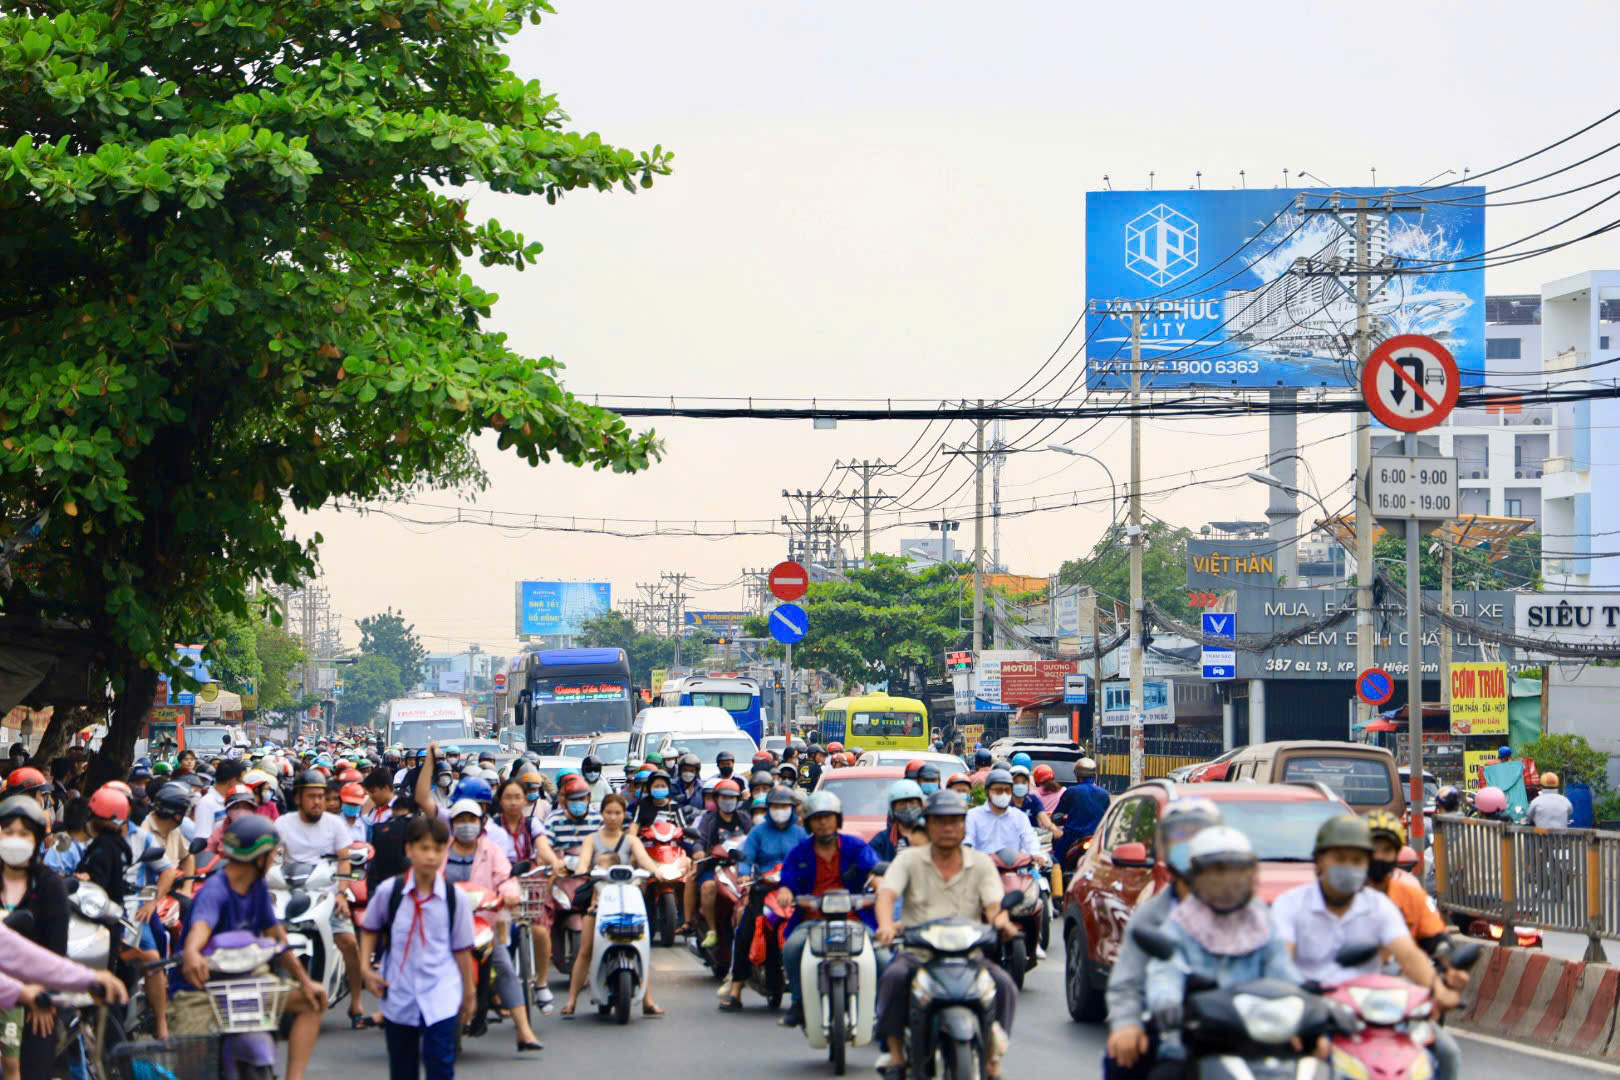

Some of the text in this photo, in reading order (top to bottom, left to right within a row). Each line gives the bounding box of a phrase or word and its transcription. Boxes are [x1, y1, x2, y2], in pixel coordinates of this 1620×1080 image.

[1139, 322, 1186, 337] CITY
[1171, 360, 1212, 374] 1800
[1215, 360, 1259, 374] 6363
[1381, 468, 1406, 484] 6:00
[1420, 469, 1447, 485] 9:00
[1378, 493, 1406, 509] 16:00
[1420, 495, 1450, 510] 19:00
[1192, 552, 1232, 576] VIỆT
[1478, 603, 1504, 618] XE
[1528, 599, 1620, 628] SIÊU T
[1002, 664, 1034, 673] MOTUL
[1264, 659, 1292, 672] 387
[1295, 661, 1311, 672] QL
[1452, 667, 1505, 699] CƠM TRƯA
